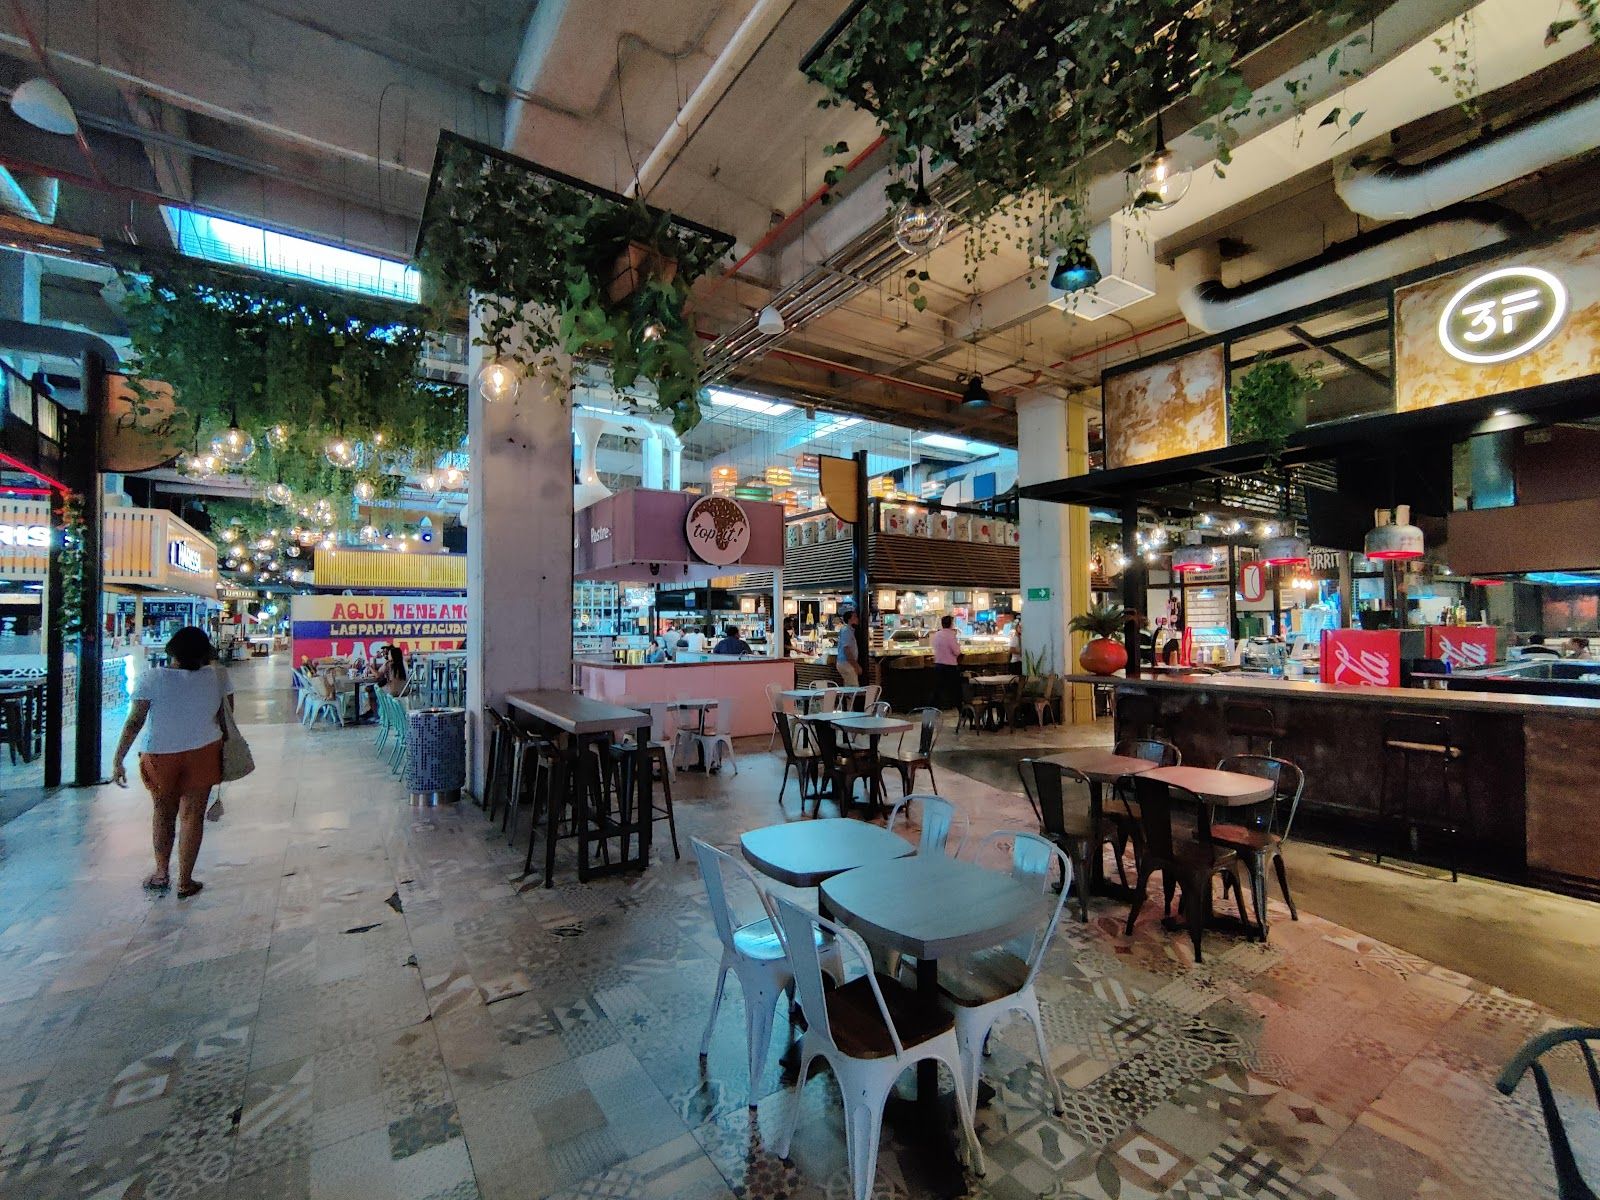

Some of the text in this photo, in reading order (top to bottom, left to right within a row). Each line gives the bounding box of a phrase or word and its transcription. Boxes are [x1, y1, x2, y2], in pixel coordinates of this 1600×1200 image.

[1461, 289, 1539, 342] 3F
[694, 523, 716, 544] top
[1309, 552, 1340, 570] URRIT
[393, 603, 467, 620] MENEAM
[330, 624, 358, 636] LAS
[359, 624, 412, 636] PAPITAS
